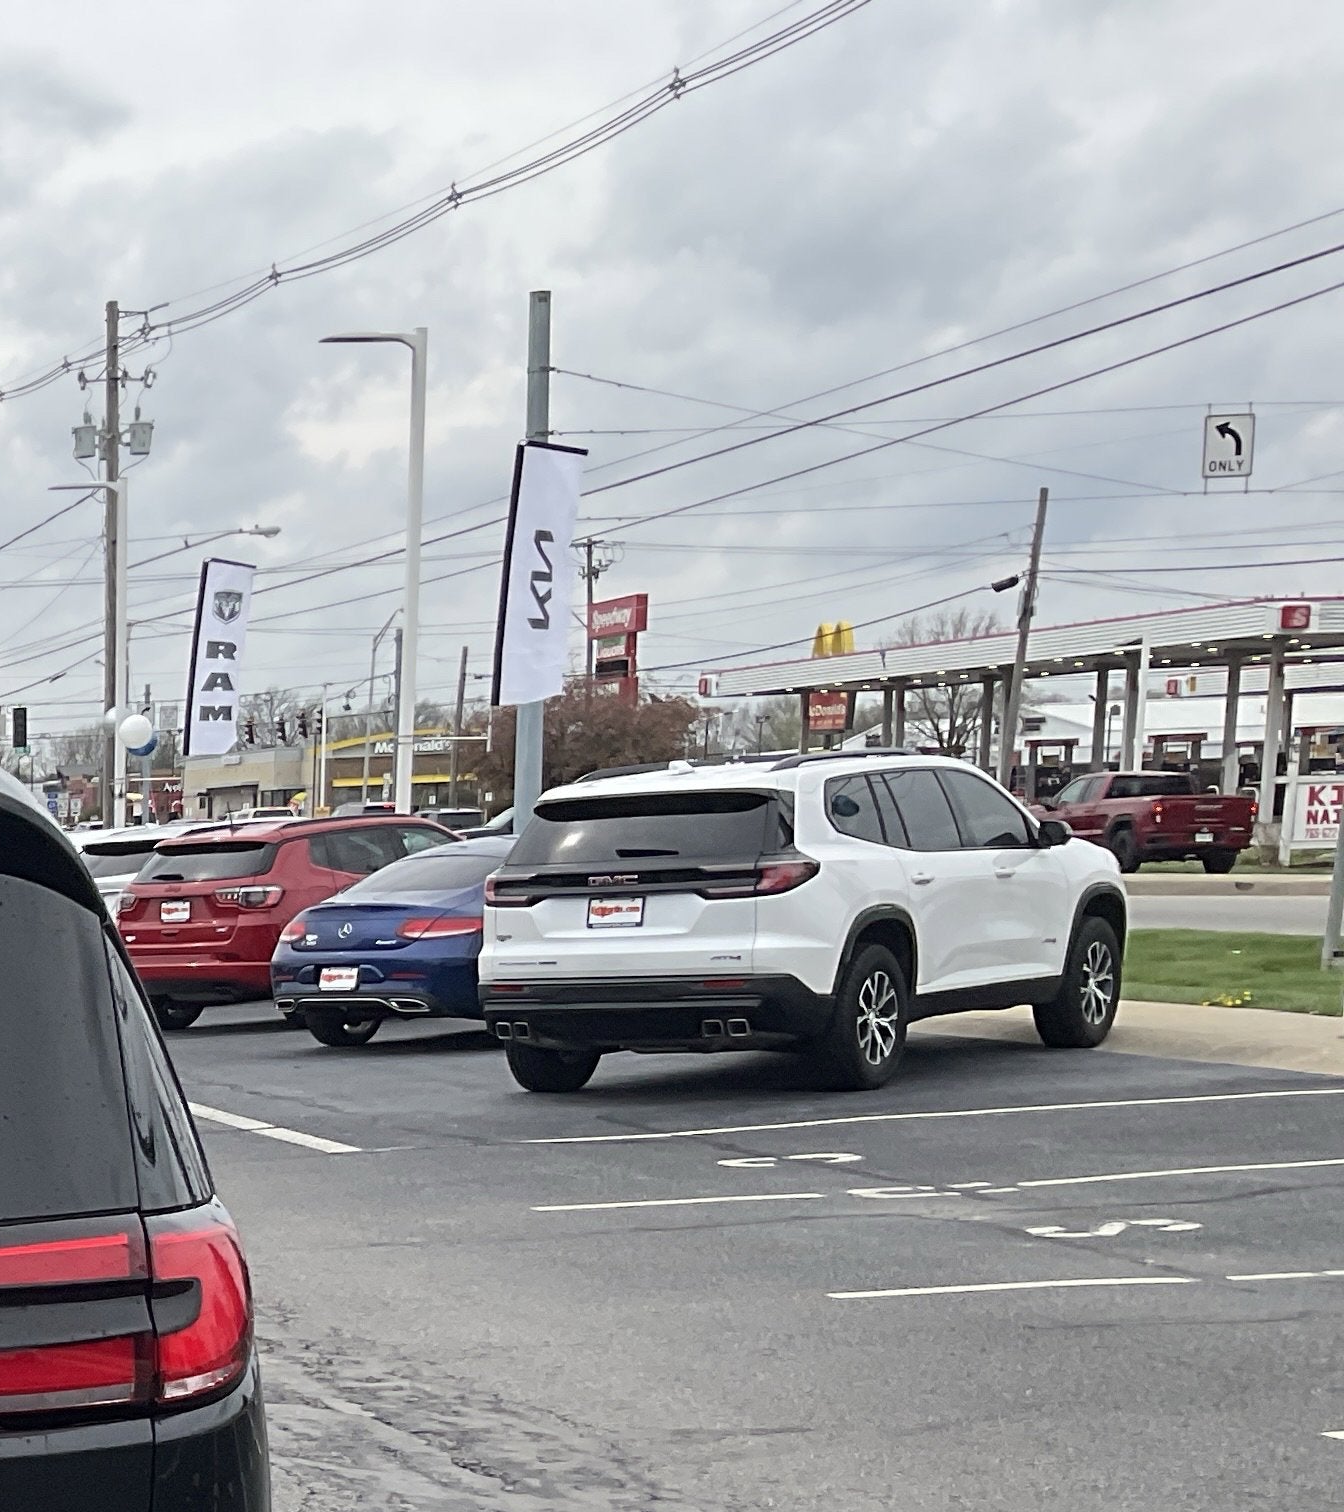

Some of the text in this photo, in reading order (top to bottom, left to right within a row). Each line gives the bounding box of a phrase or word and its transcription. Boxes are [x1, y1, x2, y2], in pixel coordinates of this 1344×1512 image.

[1208, 460, 1245, 472] ONLY
[199, 640, 238, 722] RAM
[374, 738, 453, 755] Mcnald's
[587, 874, 639, 887] GMC
